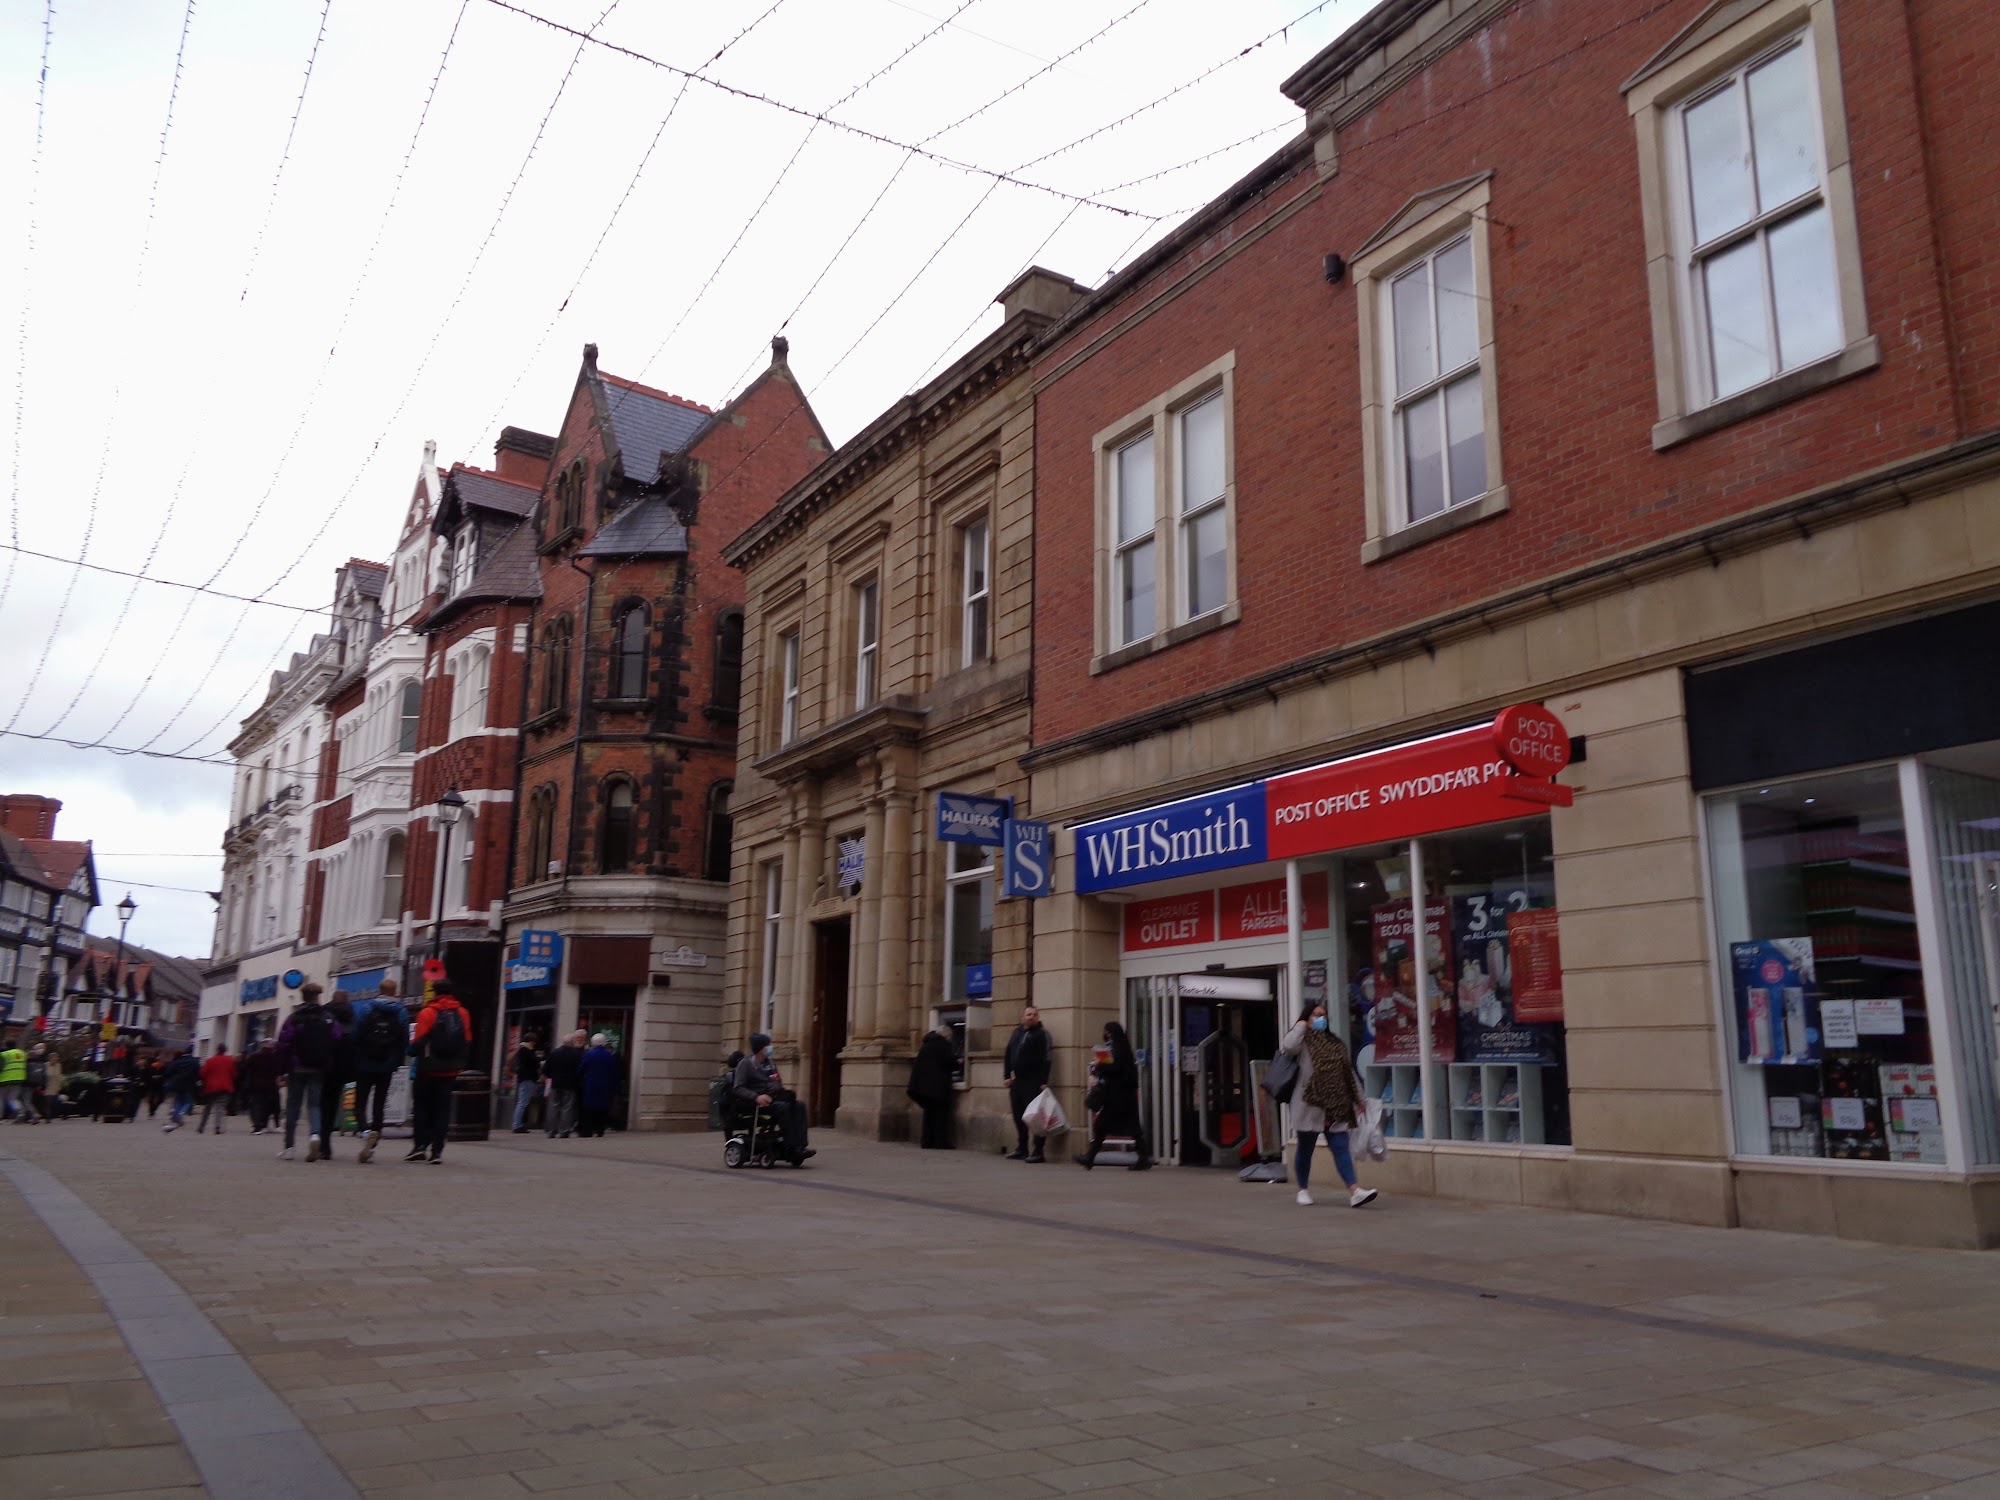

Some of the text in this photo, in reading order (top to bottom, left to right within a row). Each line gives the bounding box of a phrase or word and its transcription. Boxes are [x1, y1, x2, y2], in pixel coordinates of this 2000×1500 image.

[1518, 717, 1556, 739] POST
[1509, 737, 1563, 763] OFFICE
[1275, 801, 1314, 826] POST
[1314, 789, 1371, 817] OFFICE
[1379, 765, 1482, 805] SWYDDFA'R
[941, 809, 1000, 829] HALIFAX
[1014, 824, 1044, 842] WH
[1085, 801, 1252, 879] WHSmith
[837, 853, 865, 873] HALIF
[1014, 840, 1044, 891] S
[1141, 901, 1200, 922] CLEARANCE
[1375, 911, 1396, 923] New
[1467, 895, 1488, 931] 3
[1490, 906, 1506, 917] for
[1141, 918, 1200, 944] OUTLET
[1381, 924, 1401, 937] ECO
